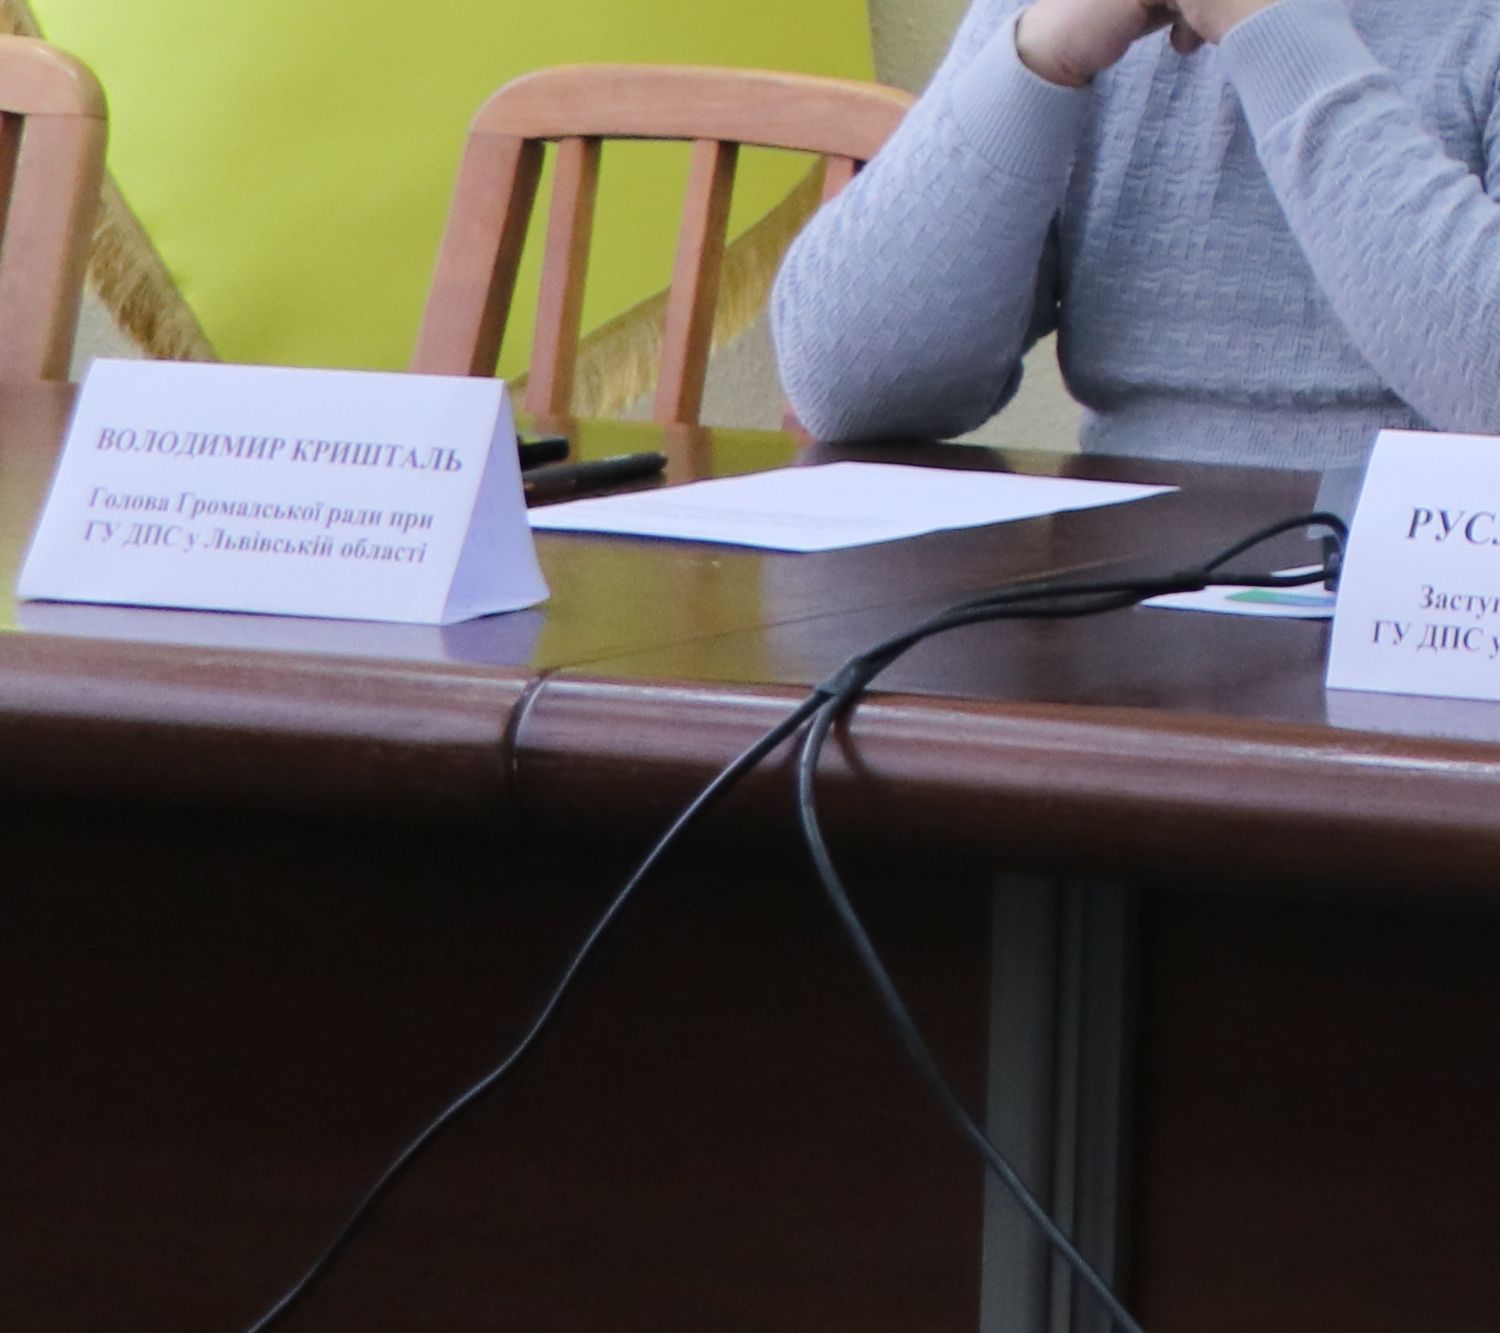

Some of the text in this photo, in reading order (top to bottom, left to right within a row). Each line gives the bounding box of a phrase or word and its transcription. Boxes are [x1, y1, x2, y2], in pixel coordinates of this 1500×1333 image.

[95, 426, 464, 473] ВОЛОДИМИР КРИШТАЛЬ
[87, 486, 434, 536] Голова Громадської ради при
[83, 520, 428, 564] ГУ ДПС у Львівській області
[1371, 619, 1412, 647] ГУ
[1416, 623, 1484, 653] ДПС
